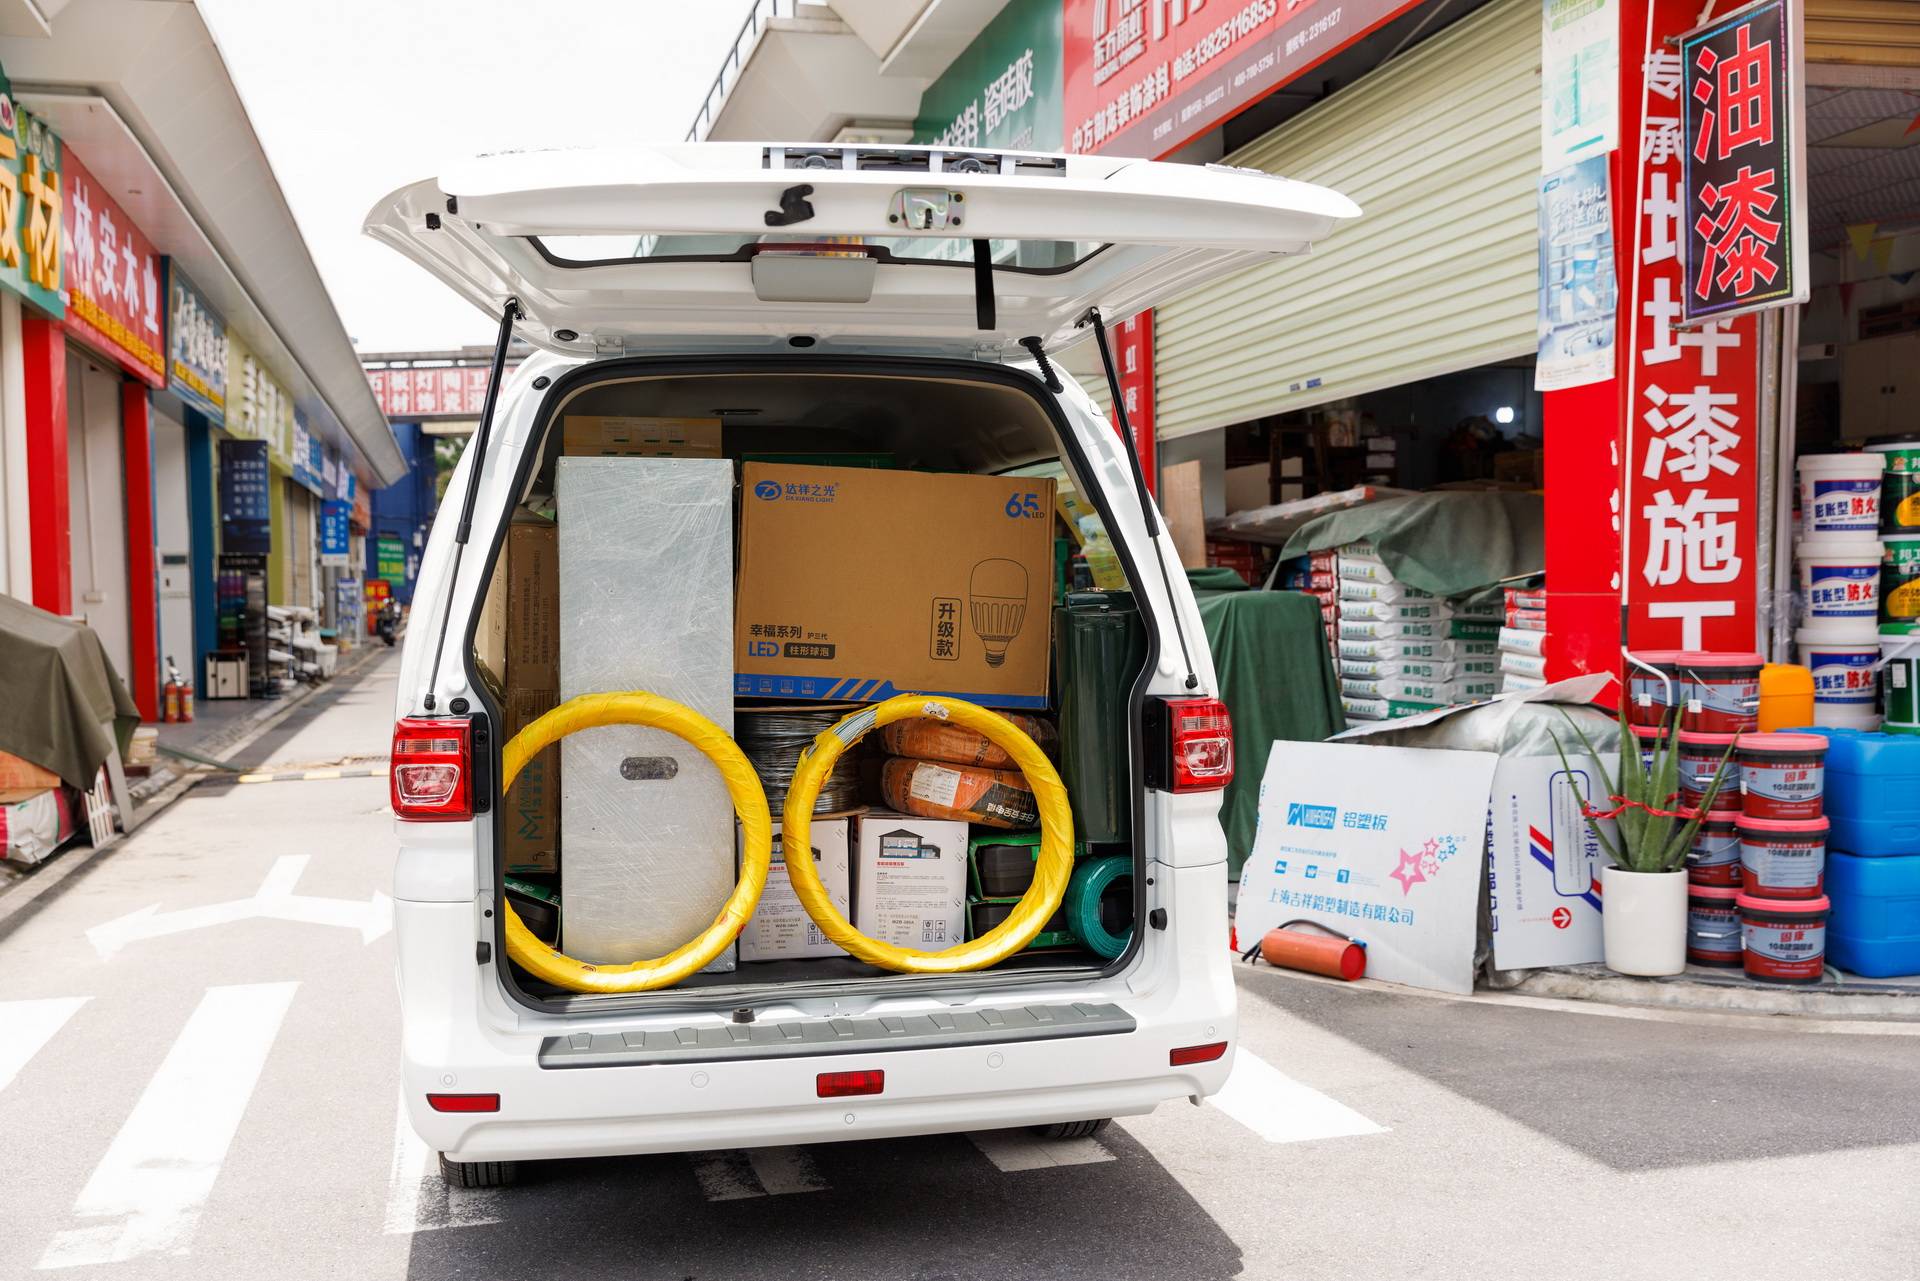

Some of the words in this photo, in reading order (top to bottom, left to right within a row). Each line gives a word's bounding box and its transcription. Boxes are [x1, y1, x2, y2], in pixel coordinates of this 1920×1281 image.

[1693, 23, 1782, 300] 油漆
[785, 483, 835, 496] 达祥之光
[1005, 493, 1040, 518] 65
[750, 624, 802, 638] 幸福系列
[936, 603, 956, 656] 升级款
[748, 641, 780, 657] LED
[789, 645, 830, 657] 柱形球泡
[1343, 811, 1388, 831] 铝塑板
